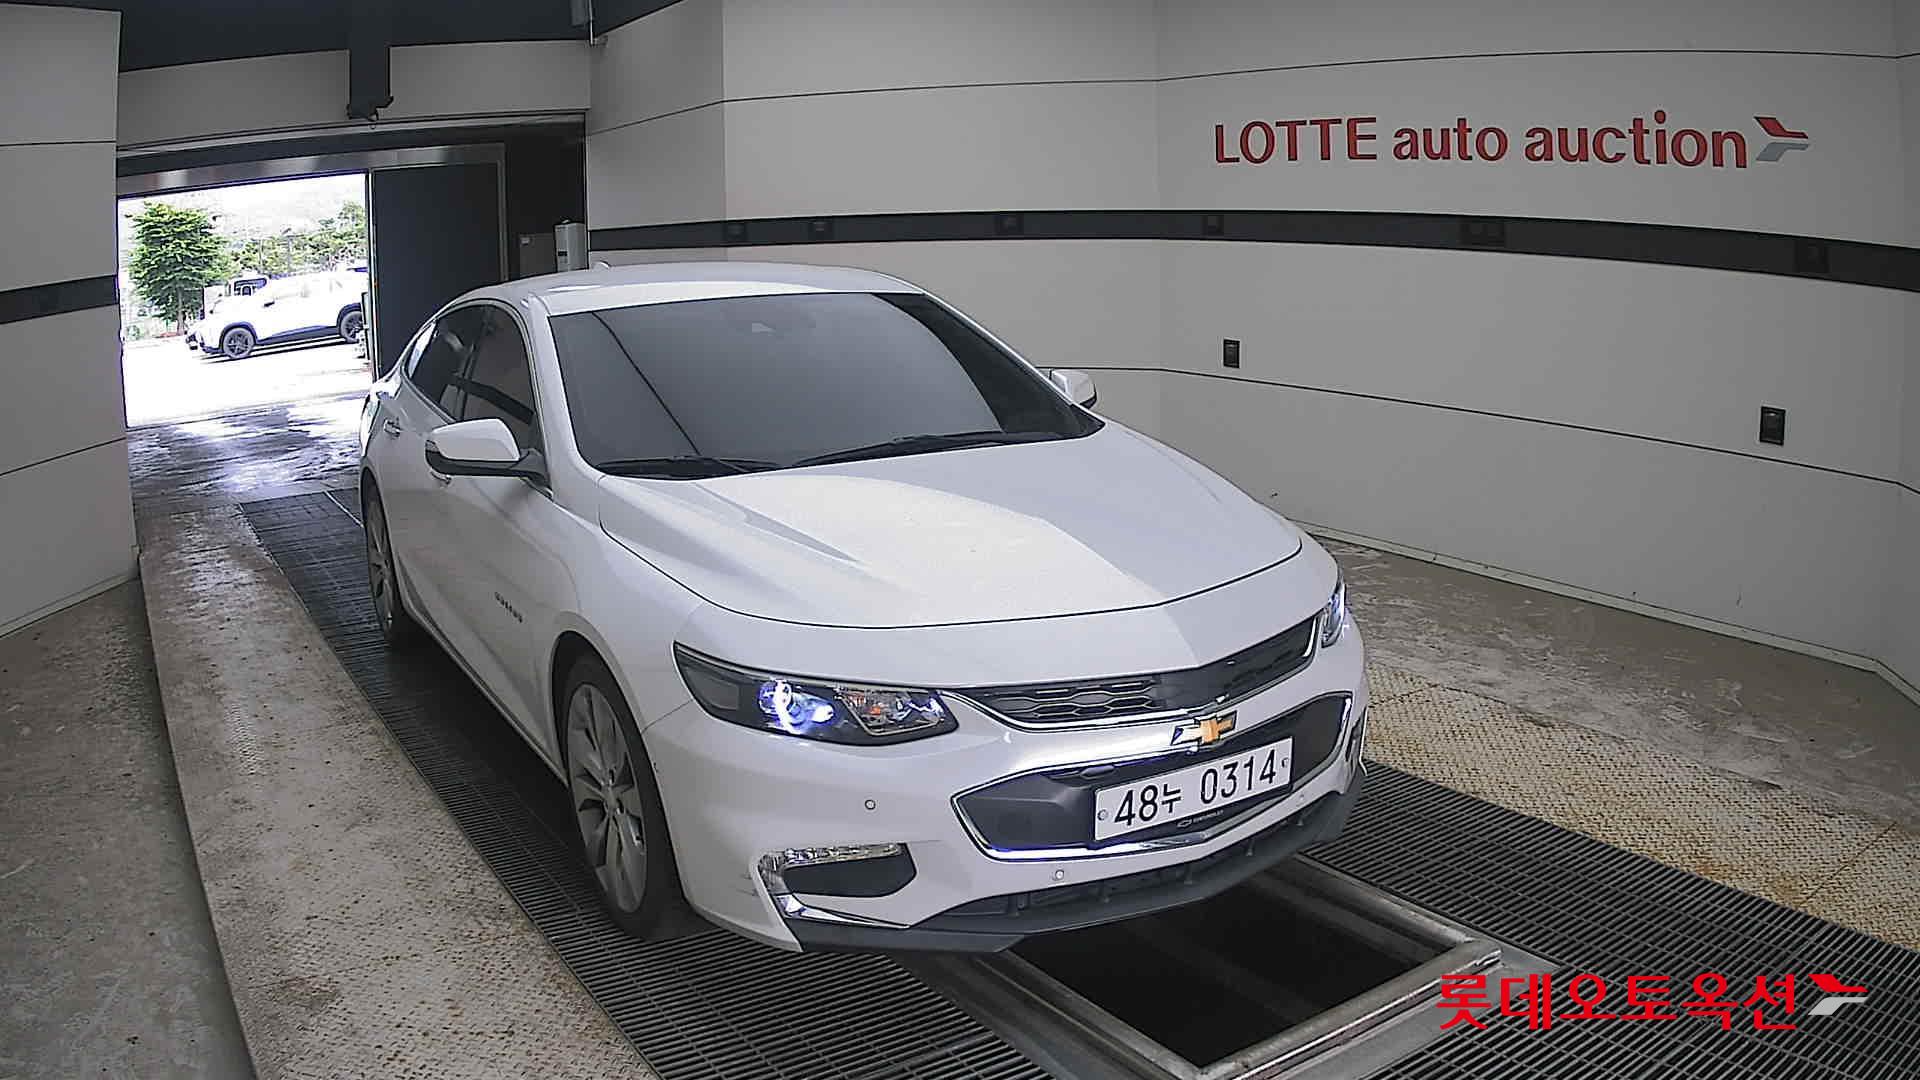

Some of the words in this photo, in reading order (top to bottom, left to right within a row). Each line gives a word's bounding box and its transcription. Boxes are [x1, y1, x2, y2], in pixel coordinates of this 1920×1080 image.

[1215, 117, 1377, 164] LOTTE
[1392, 117, 1509, 162] auto
[1524, 109, 1747, 168] auction
[1114, 783, 1181, 826] 48누
[1200, 749, 1276, 804] 0314
